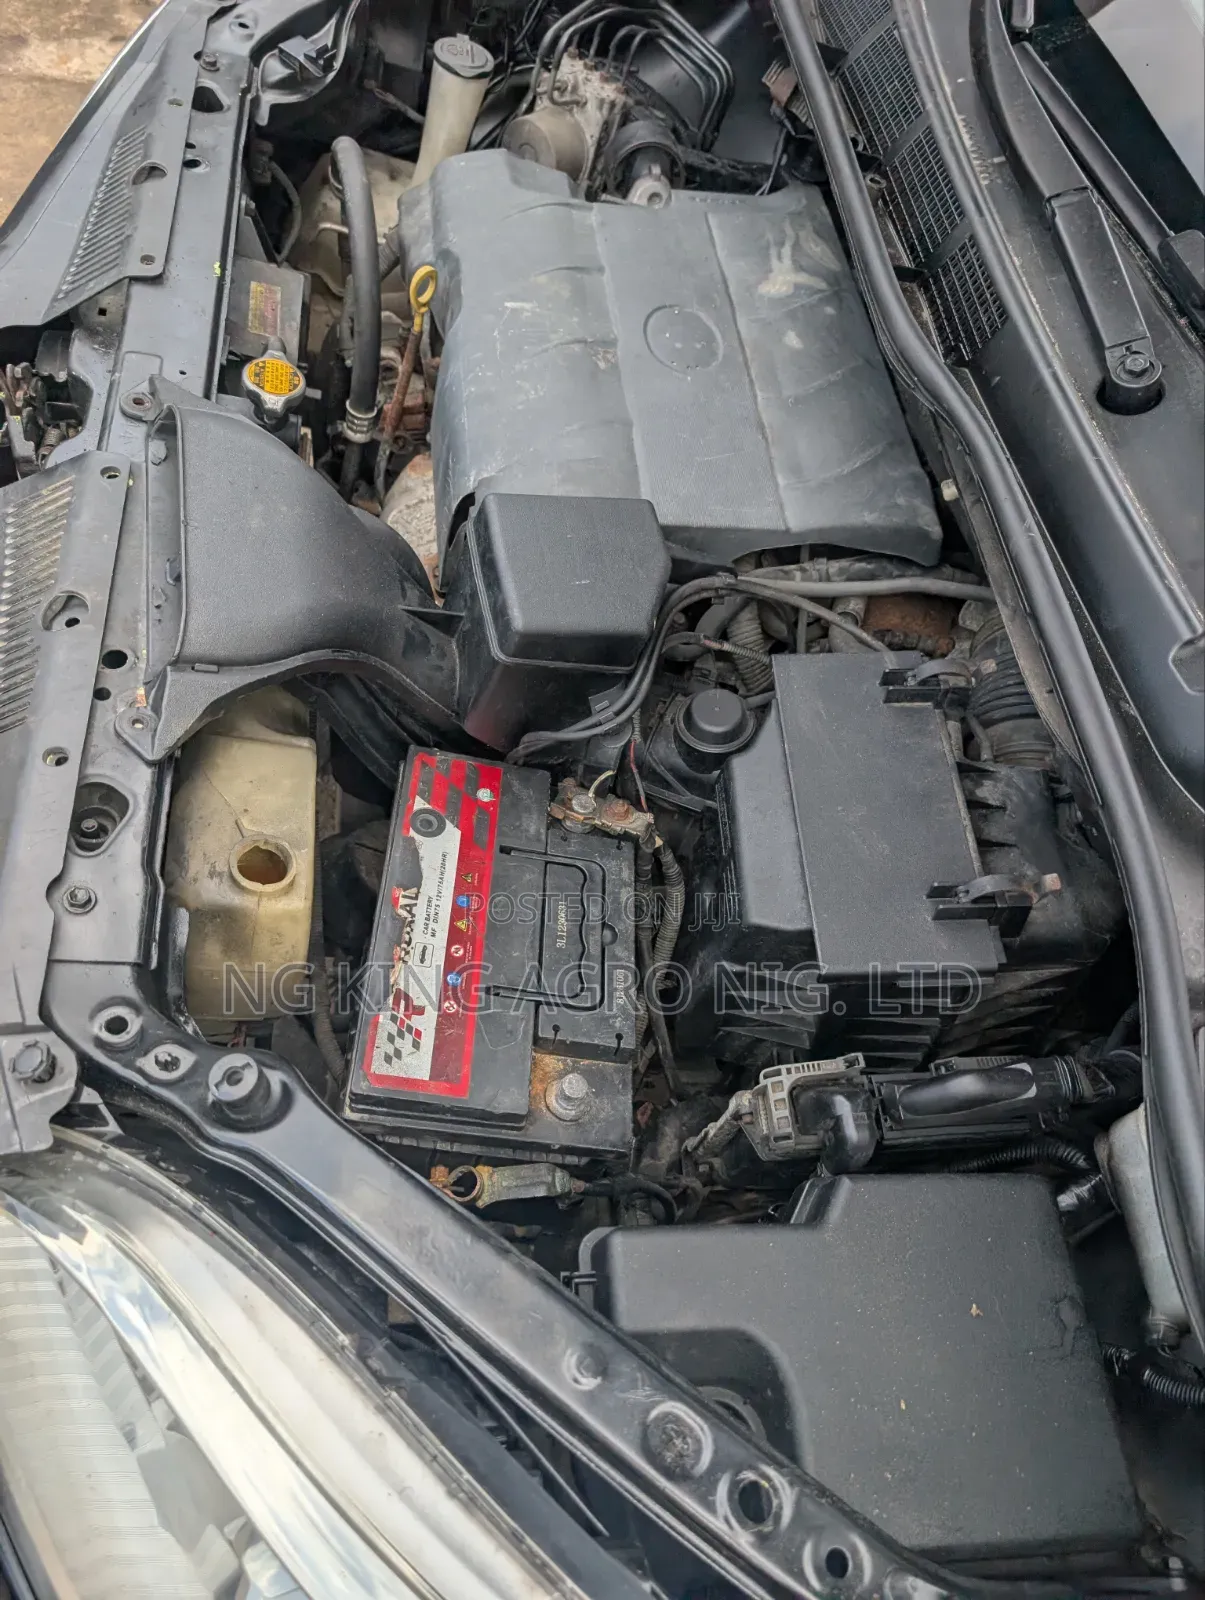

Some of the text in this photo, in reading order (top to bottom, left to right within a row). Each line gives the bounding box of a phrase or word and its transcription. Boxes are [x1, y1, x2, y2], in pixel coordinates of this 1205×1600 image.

[422, 895, 434, 935] CAR BATTERY
[430, 927, 438, 938] MF
